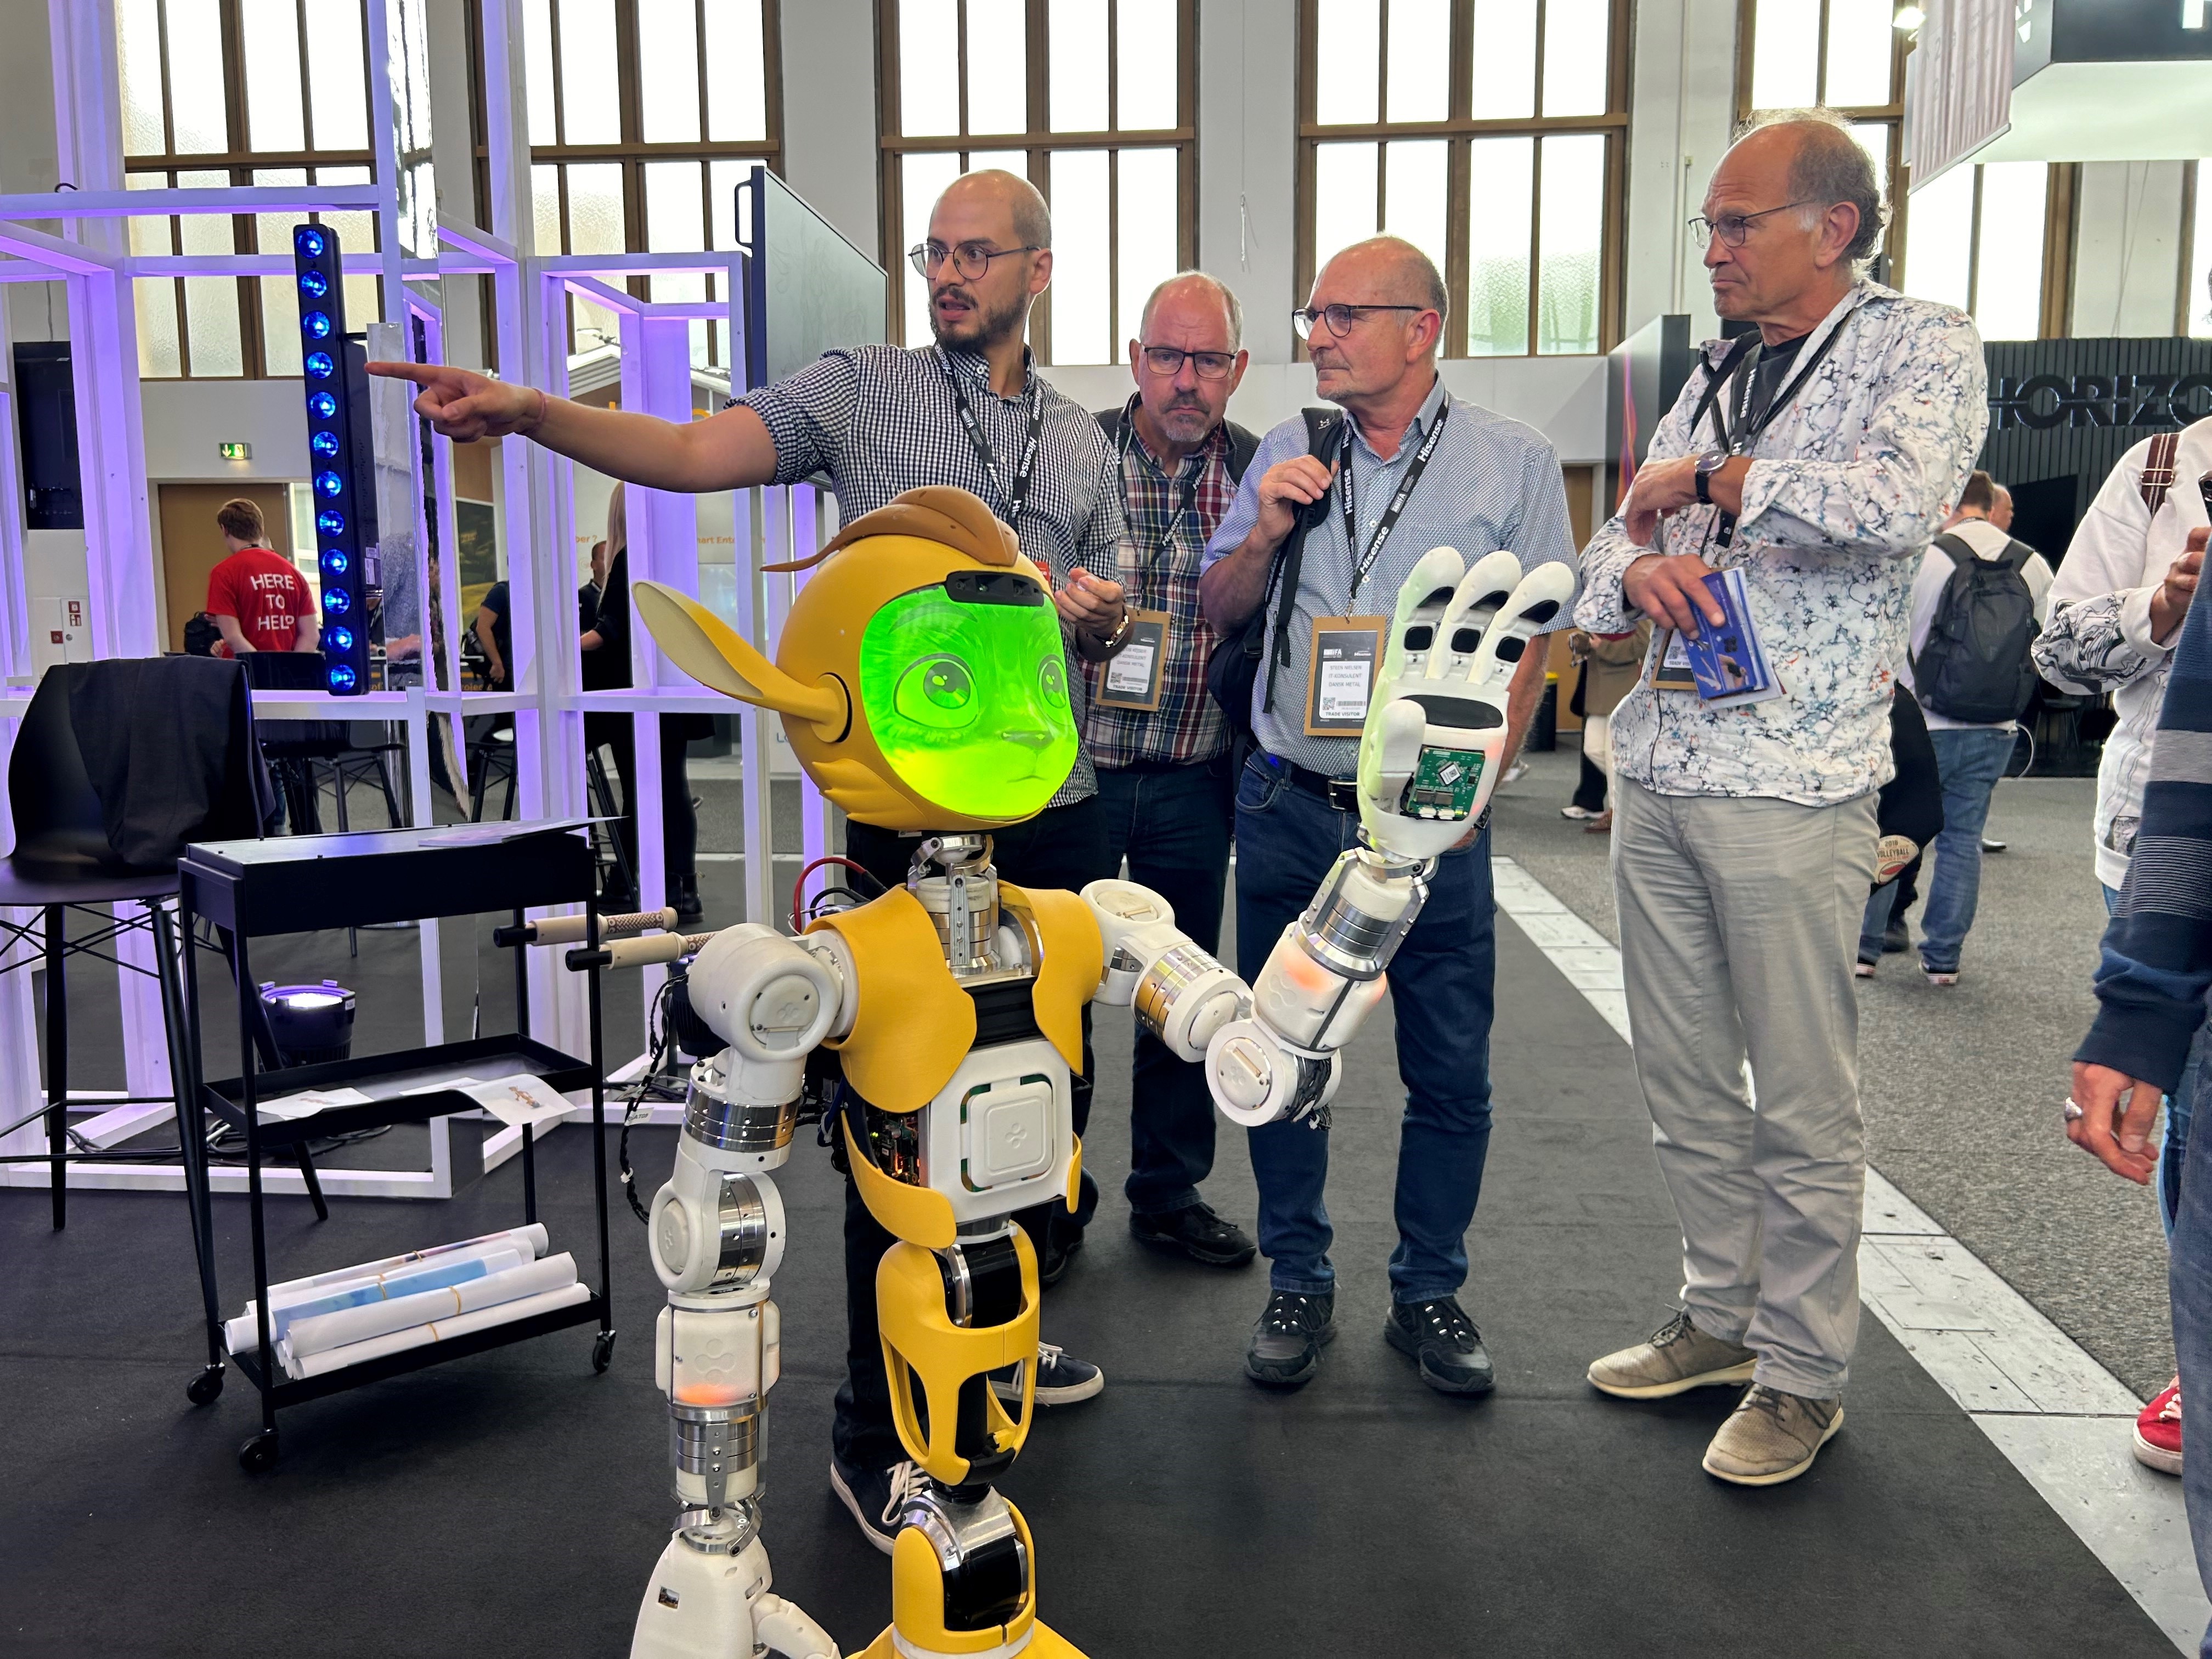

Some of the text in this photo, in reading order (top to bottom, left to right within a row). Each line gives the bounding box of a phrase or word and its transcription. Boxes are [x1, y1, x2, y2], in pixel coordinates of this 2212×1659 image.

[934, 343, 953, 375] Hisense
[1740, 368, 1757, 418] Hisense
[1020, 436, 1037, 478] Hisense
[1417, 419, 1443, 462] Hisense
[1344, 469, 1353, 515] Hisense
[1161, 507, 1186, 547] Hisense
[1359, 526, 1389, 574] Hisense
[250, 573, 295, 590] HERE
[266, 594, 285, 609] TO
[258, 615, 295, 631] HELP
